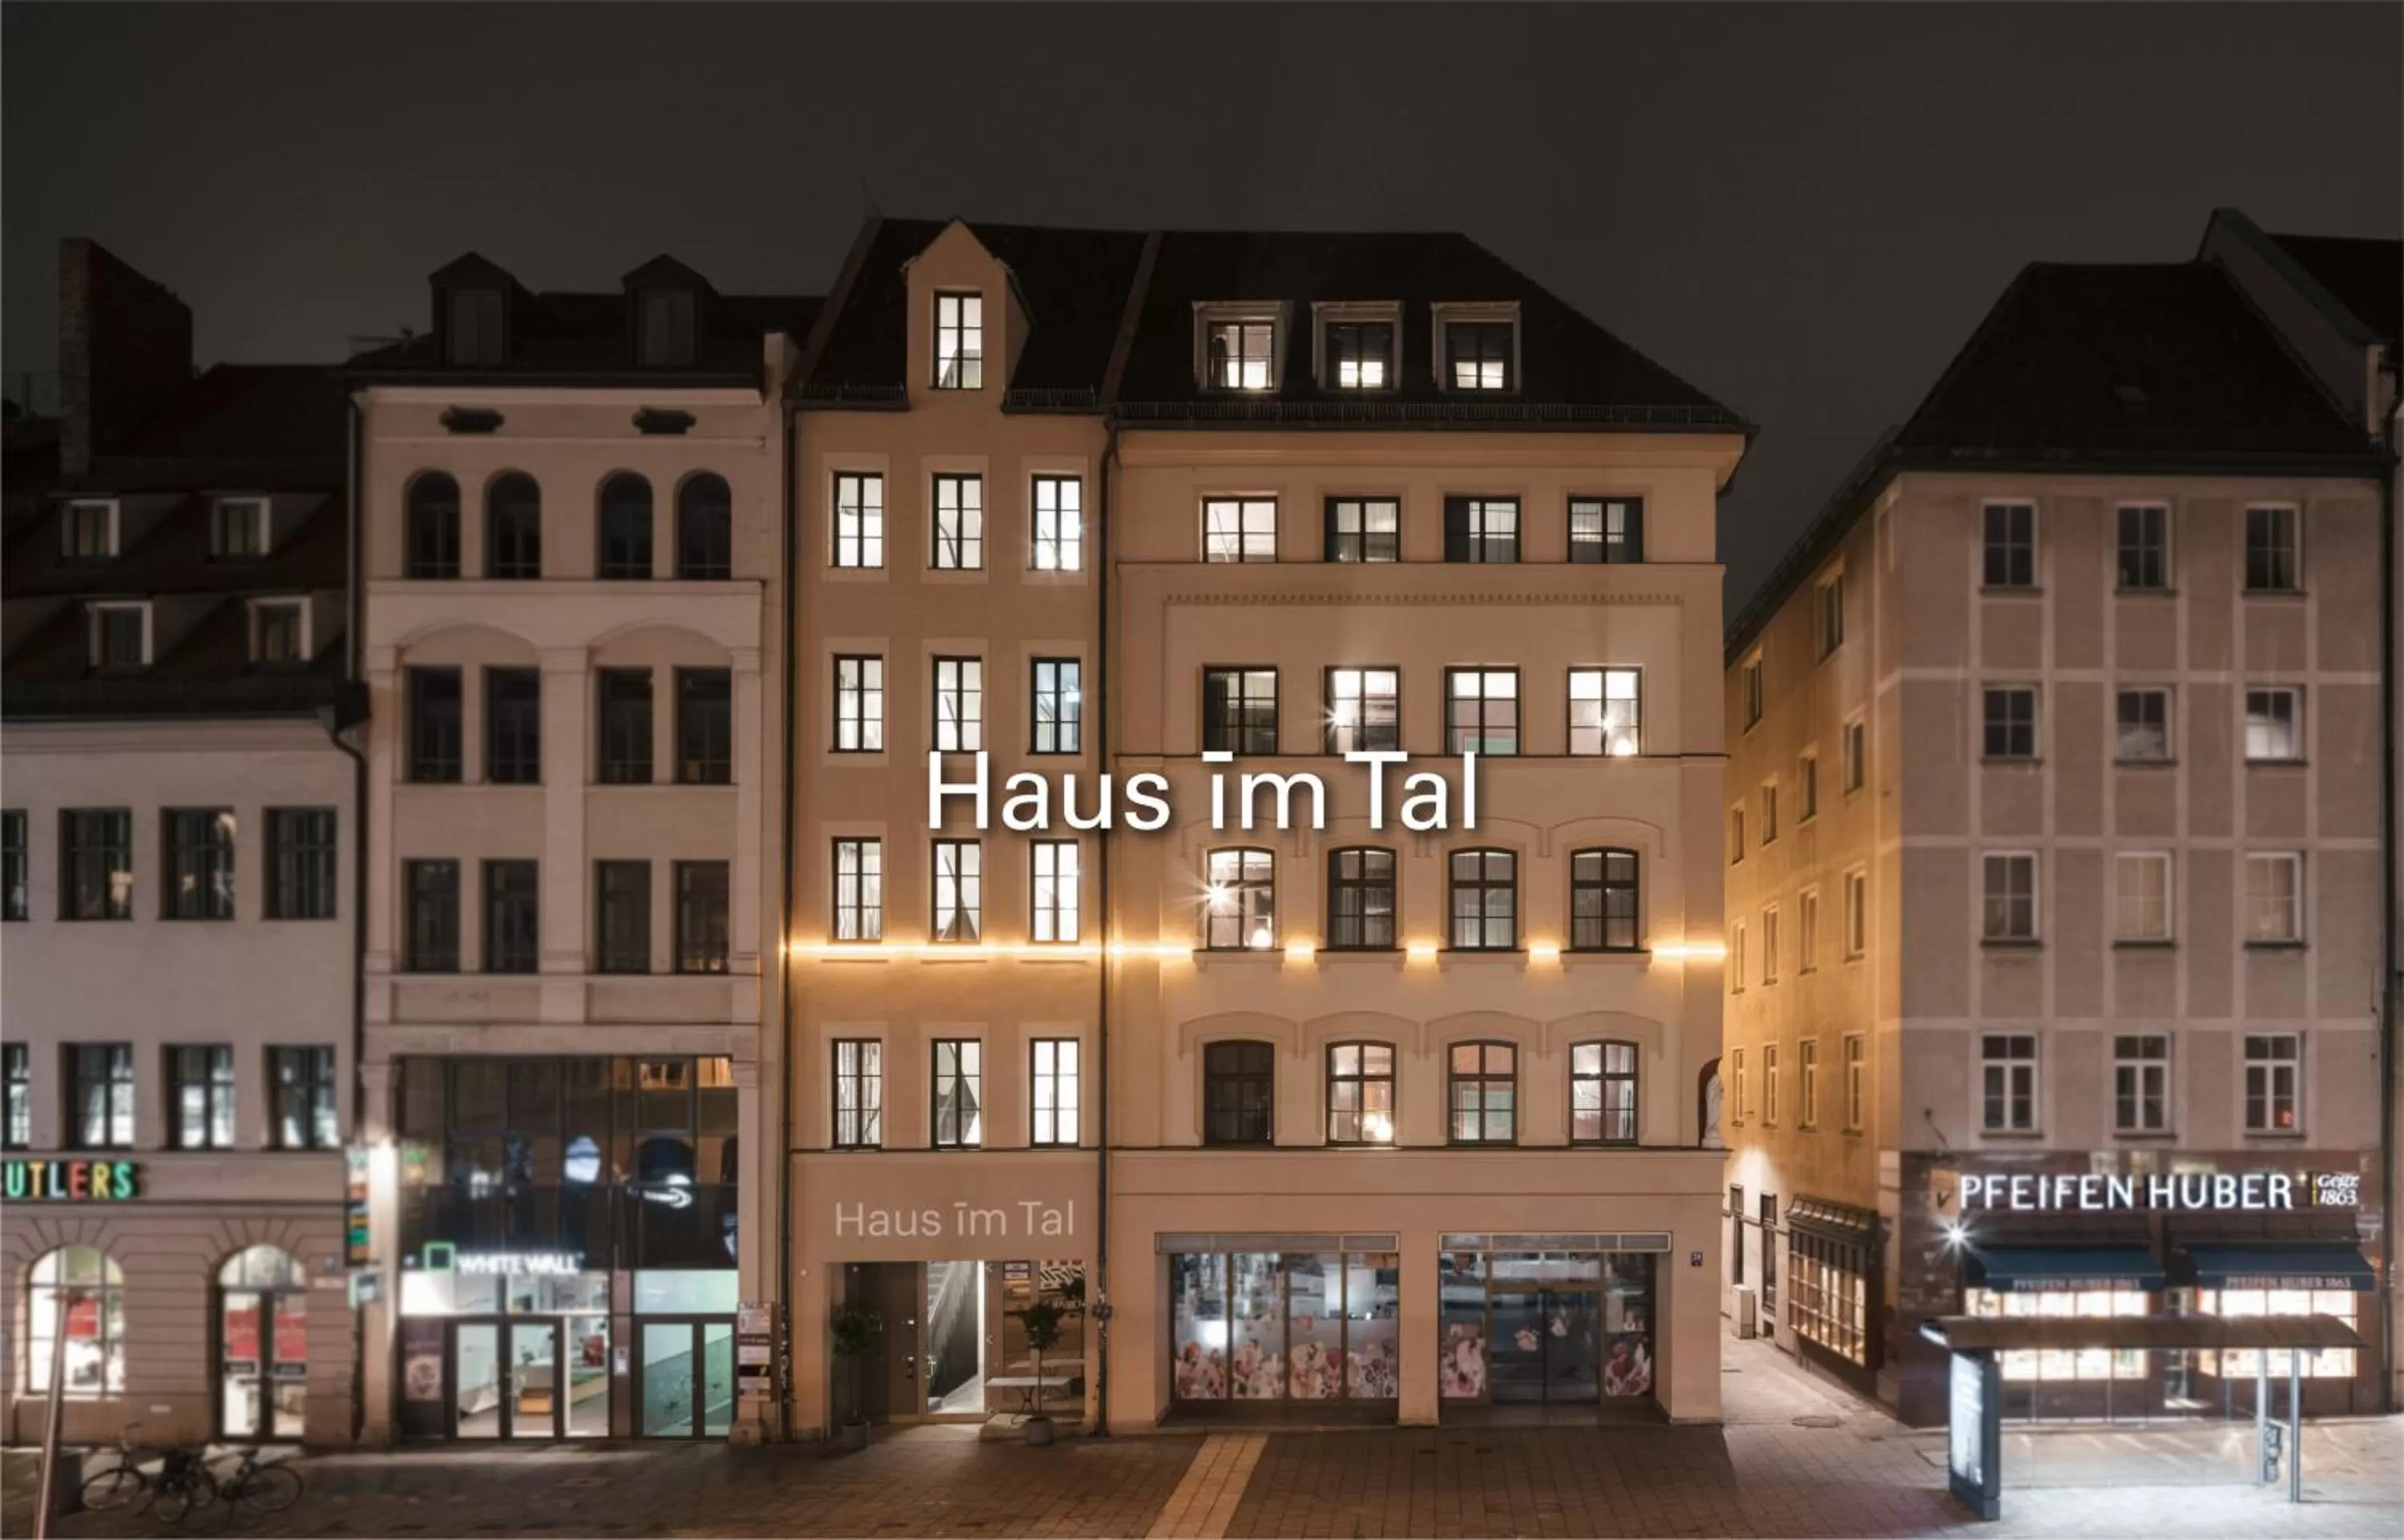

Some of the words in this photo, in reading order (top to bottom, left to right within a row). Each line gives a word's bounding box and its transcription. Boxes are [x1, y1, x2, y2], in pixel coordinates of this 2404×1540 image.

[1959, 1174, 2134, 1210] PFEIFEN
[2148, 1174, 2293, 1211] HUBER
[2320, 1188, 2358, 1206] 1863
[834, 1201, 942, 1237] Haus
[1017, 1199, 1075, 1236] Tal
